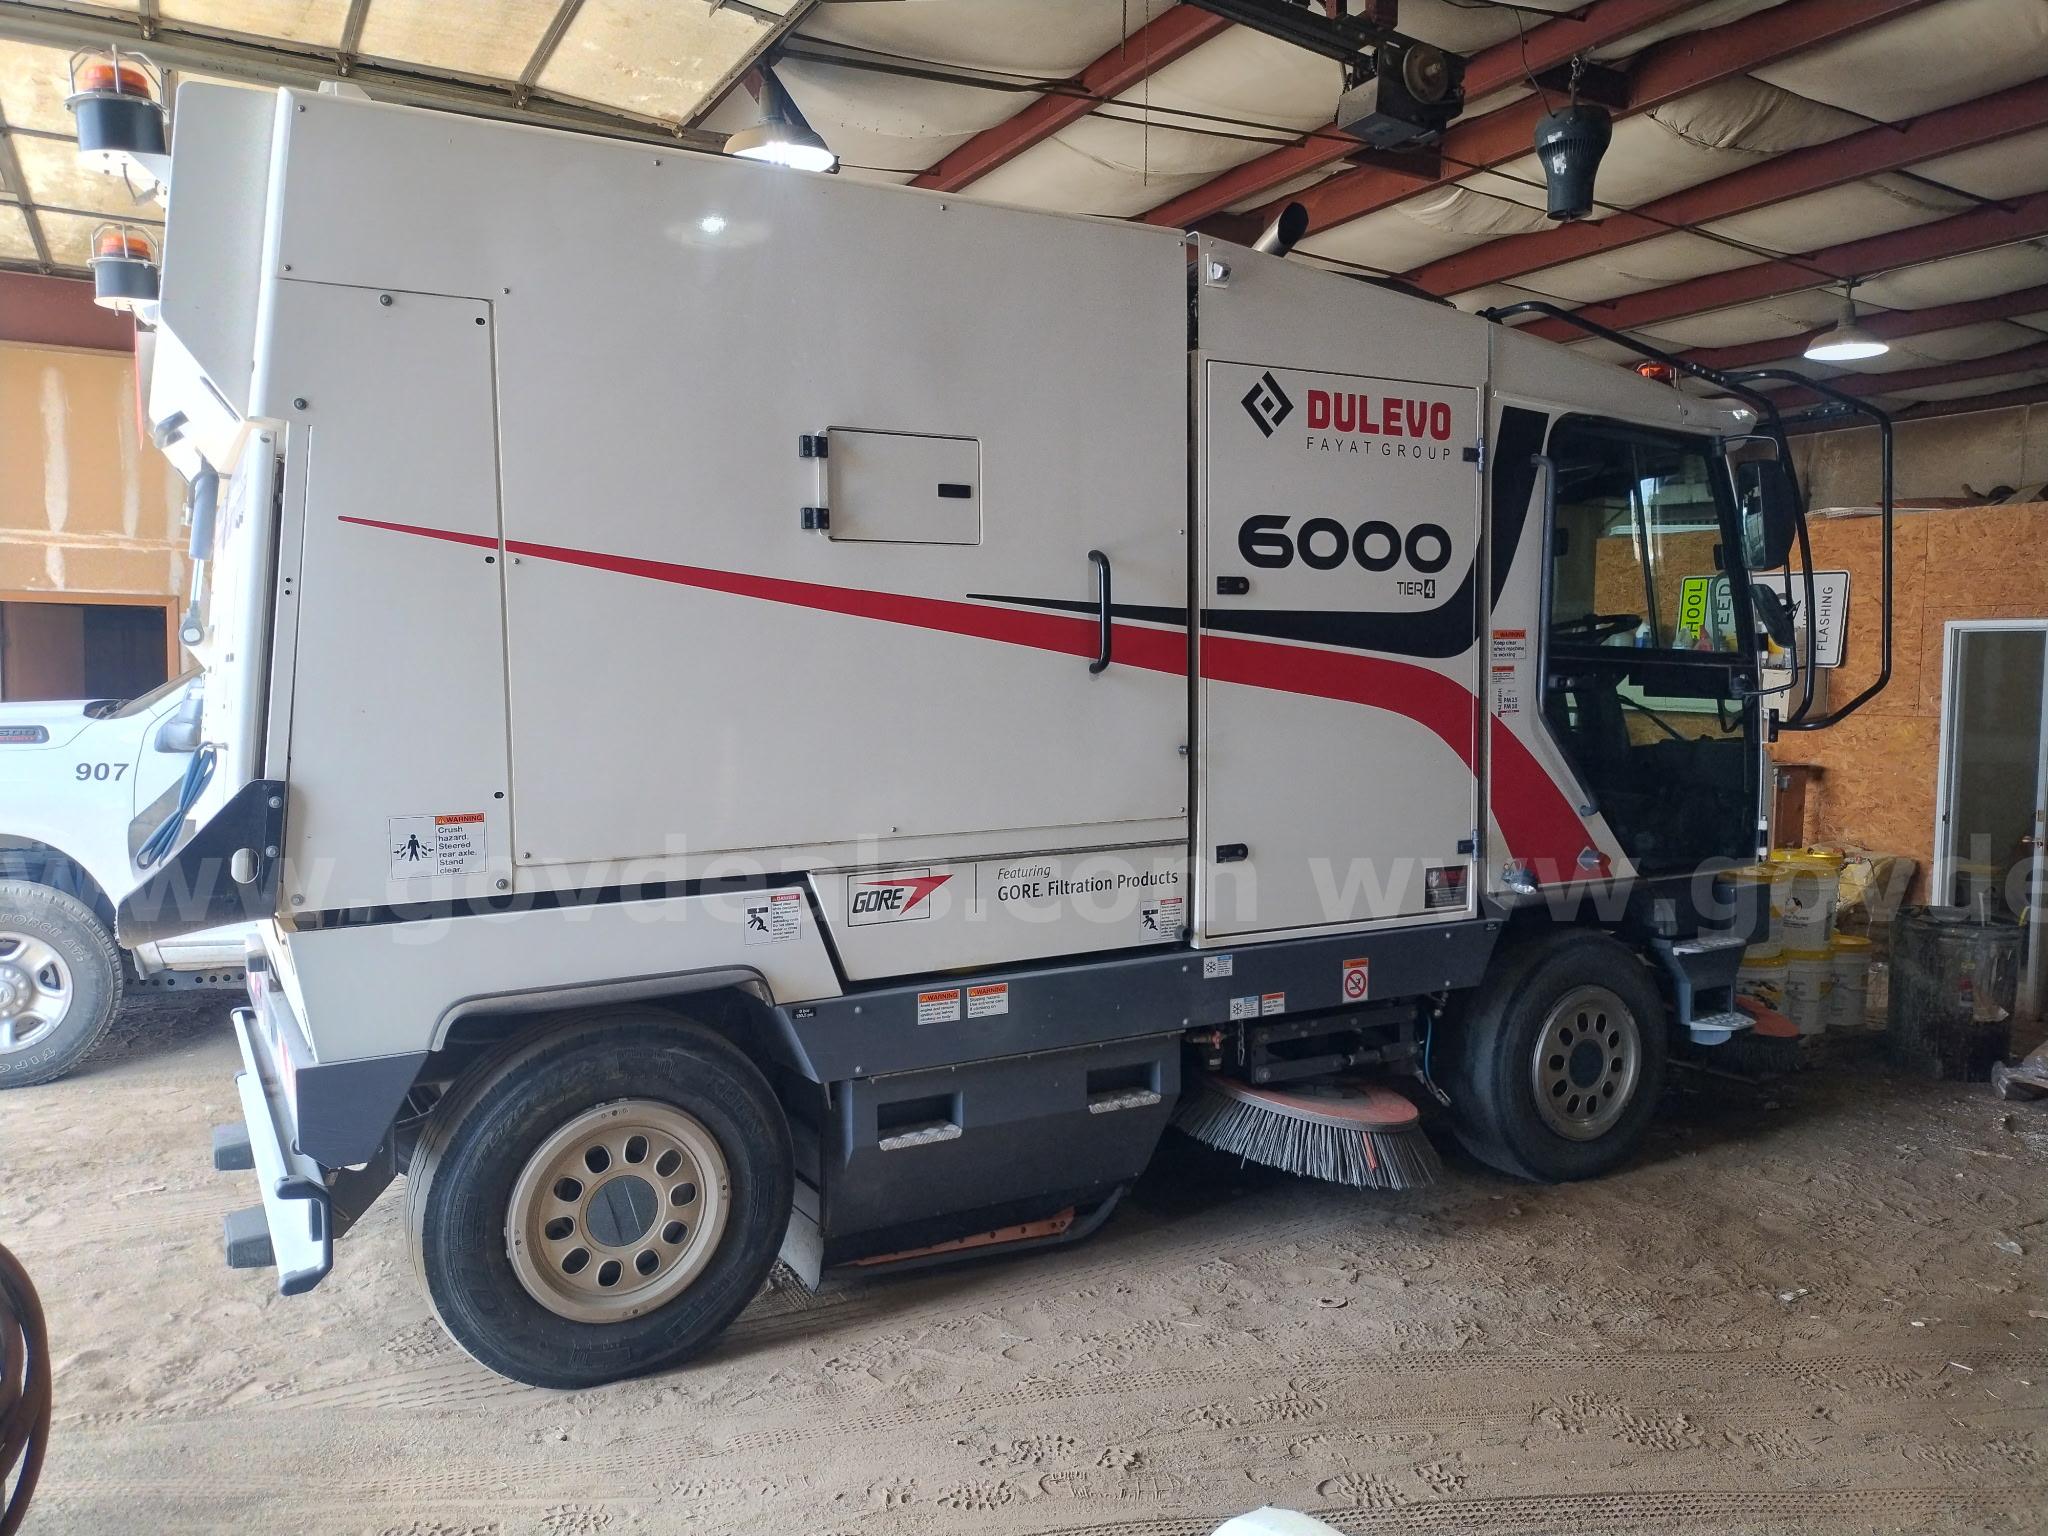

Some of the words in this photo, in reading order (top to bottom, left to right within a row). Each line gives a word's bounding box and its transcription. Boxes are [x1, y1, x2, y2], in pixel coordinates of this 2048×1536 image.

[1307, 389, 1452, 440] DULEVO
[1306, 436, 1372, 455] FAYAT
[1381, 442, 1451, 461] GROUP
[1238, 514, 1452, 574] 6000
[1686, 581, 1704, 640] HOOL
[1717, 583, 1733, 628] EED
[1816, 586, 1834, 652] FLASHING
[75, 762, 129, 781] 907
[446, 815, 483, 823] WARNING
[438, 826, 463, 834] Crush
[438, 833, 469, 842] hazard.
[438, 841, 471, 850] Steered
[458, 849, 477, 857] axle.
[439, 858, 464, 866] Stand
[439, 866, 463, 874] clear.
[997, 864, 1051, 881] Featuring
[1048, 876, 1113, 897] Filtration
[1116, 870, 1179, 889] Products
[851, 887, 905, 915] GORE
[927, 991, 958, 1001] WARNING
[977, 985, 1006, 995] WARNING
